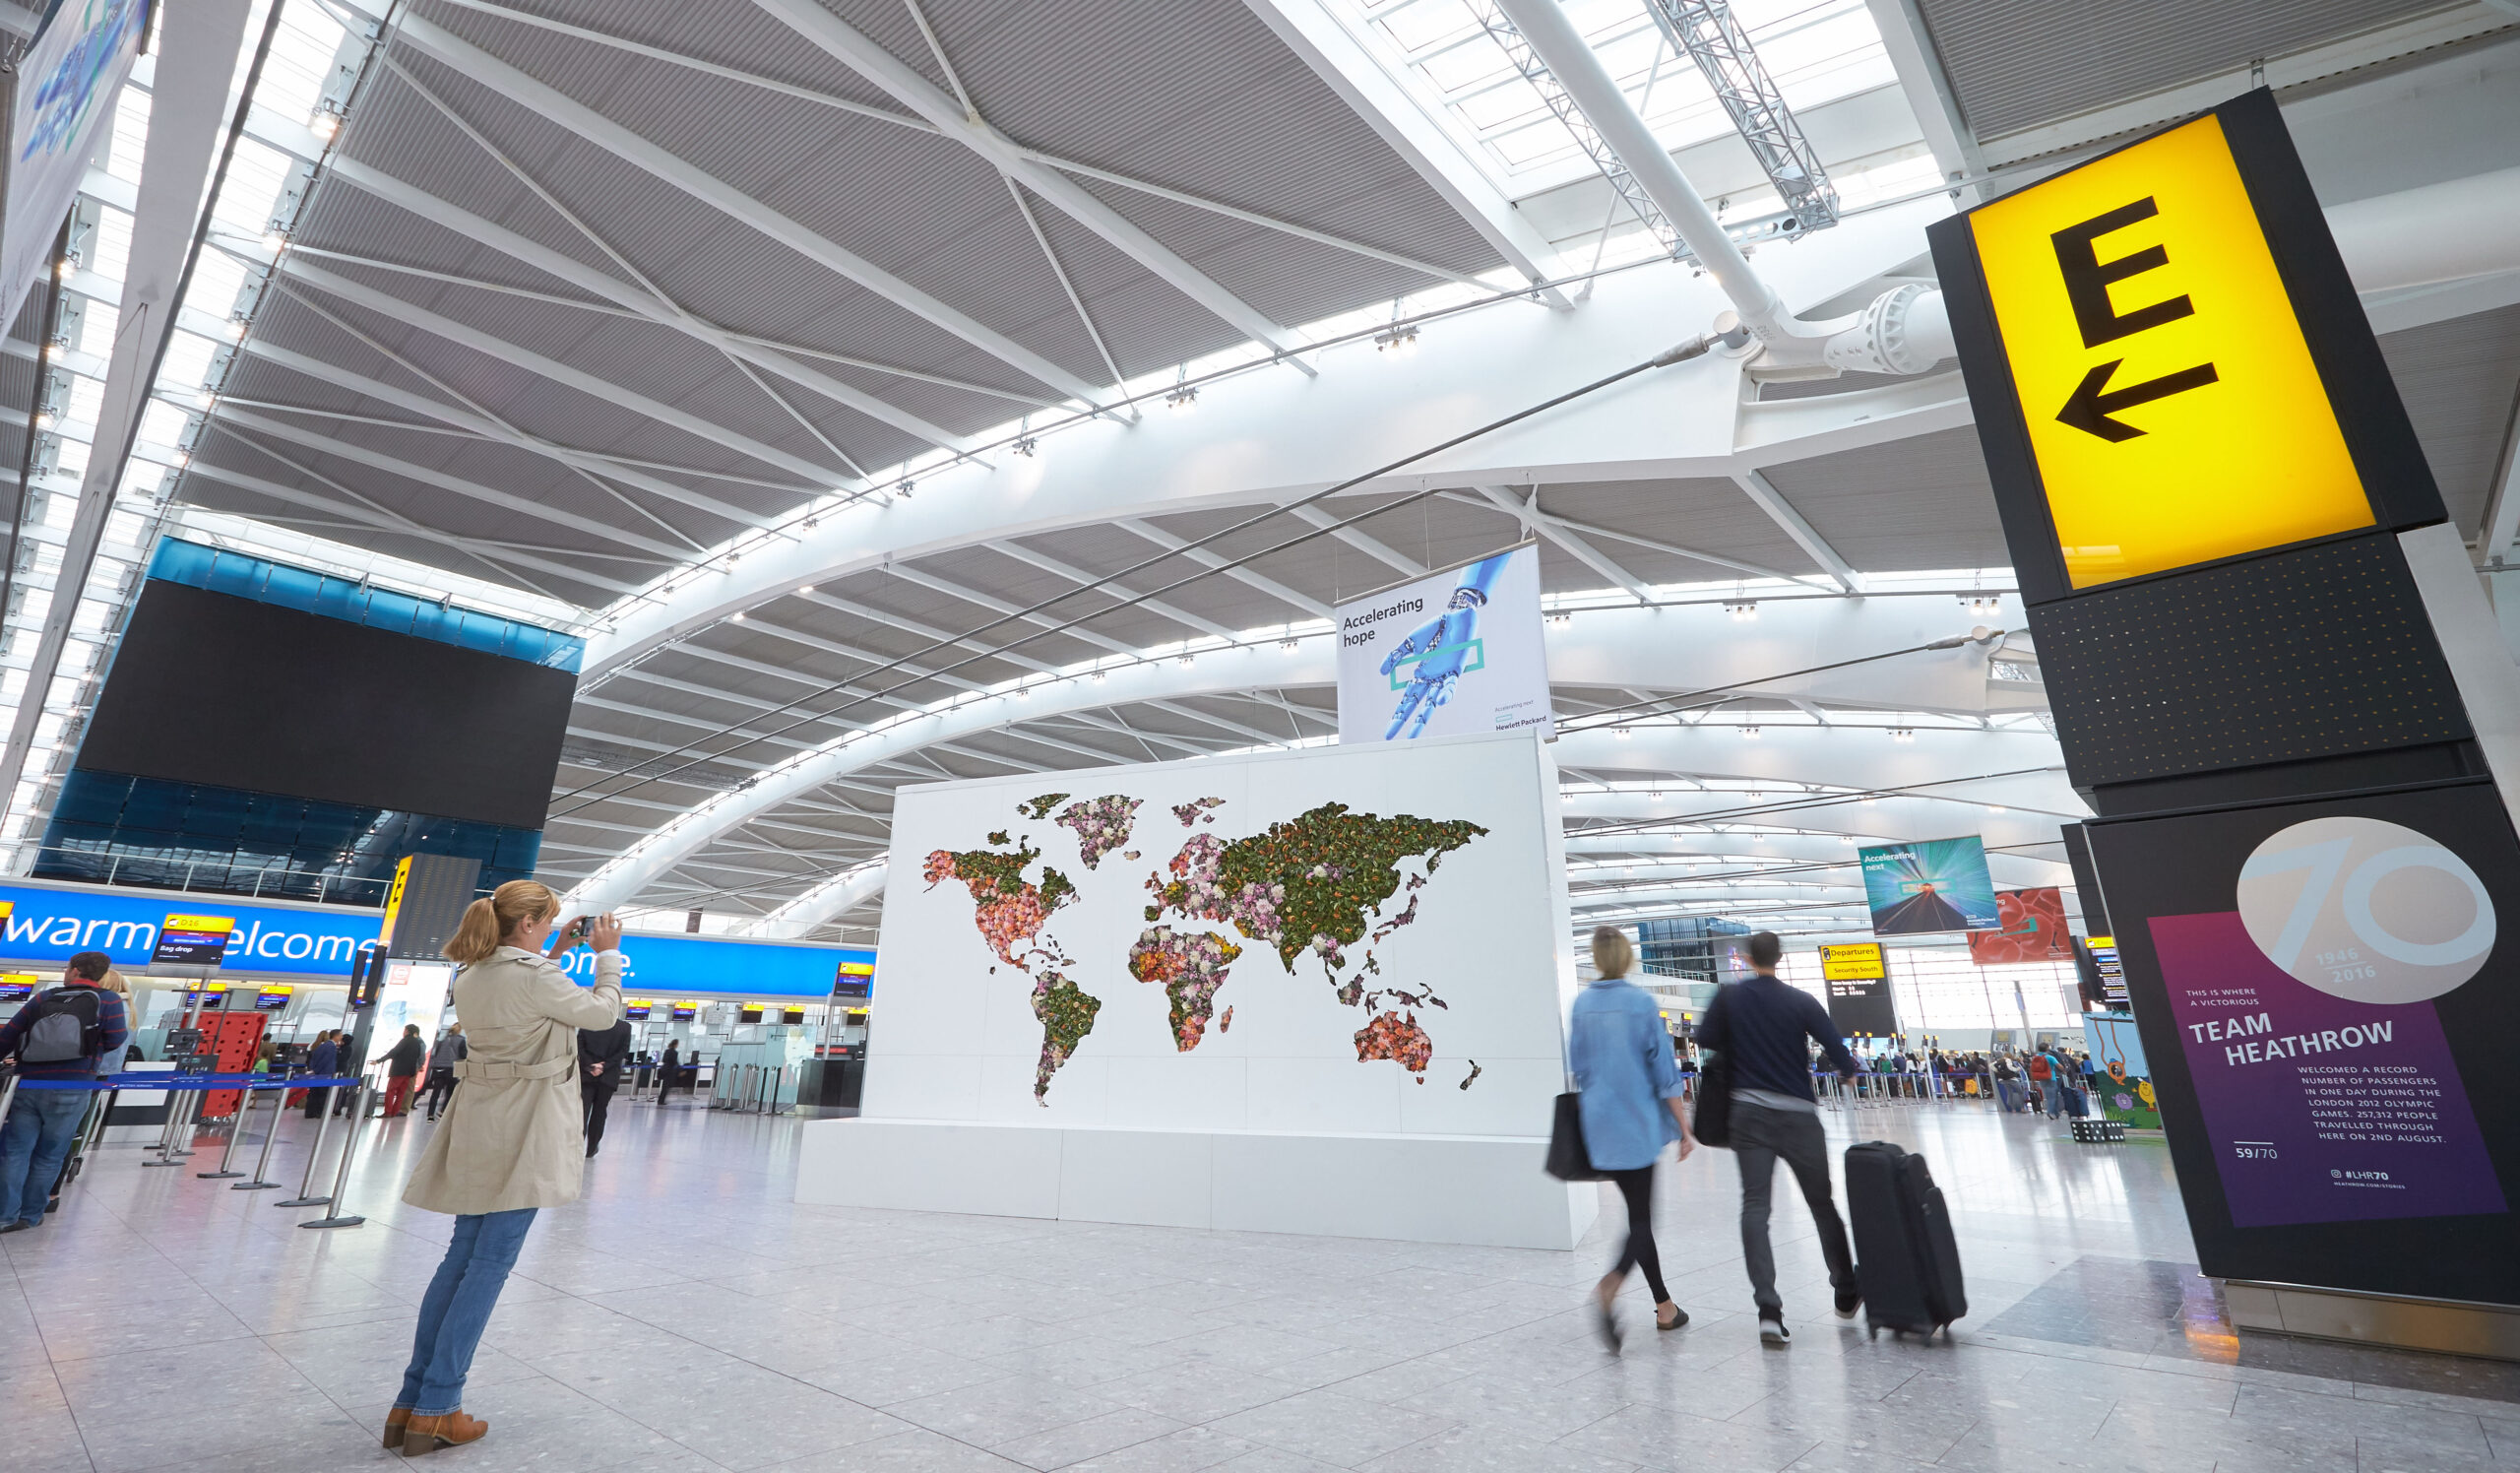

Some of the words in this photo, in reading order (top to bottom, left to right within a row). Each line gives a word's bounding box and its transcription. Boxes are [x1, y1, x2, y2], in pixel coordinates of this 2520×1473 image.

[2049, 195, 2195, 350] E
[1344, 597, 1423, 631] Accelerating
[1344, 628, 1375, 648] hope
[1495, 722, 1521, 731] Hewlett
[1521, 715, 1546, 727] Packard
[1864, 851, 1916, 864] Accelerating
[1865, 863, 1885, 871] next
[2241, 836, 2496, 974] 70
[6, 914, 157, 950] warm
[222, 921, 391, 963] elcome
[1831, 947, 1874, 957] Departures
[2315, 947, 2359, 966] 1946
[1834, 966, 1858, 975] Security
[2332, 964, 2377, 984] 2016
[2188, 1012, 2273, 1044] TEAM
[2225, 1020, 2393, 1066] HEATHROW
[2371, 1088, 2415, 1097] DURING
[2384, 1100, 2435, 1109] OLYMPIC
[2357, 1111, 2392, 1120] 257,312
[2396, 1111, 2438, 1120] PEOPLE
[2313, 1121, 2373, 1129] TRAVELLED
[2377, 1121, 2434, 1131] THROUGH
[2397, 1134, 2447, 1143] AUGUST.
[2236, 1147, 2278, 1161] 59/70
[2345, 1171, 2389, 1181] #LHR70
